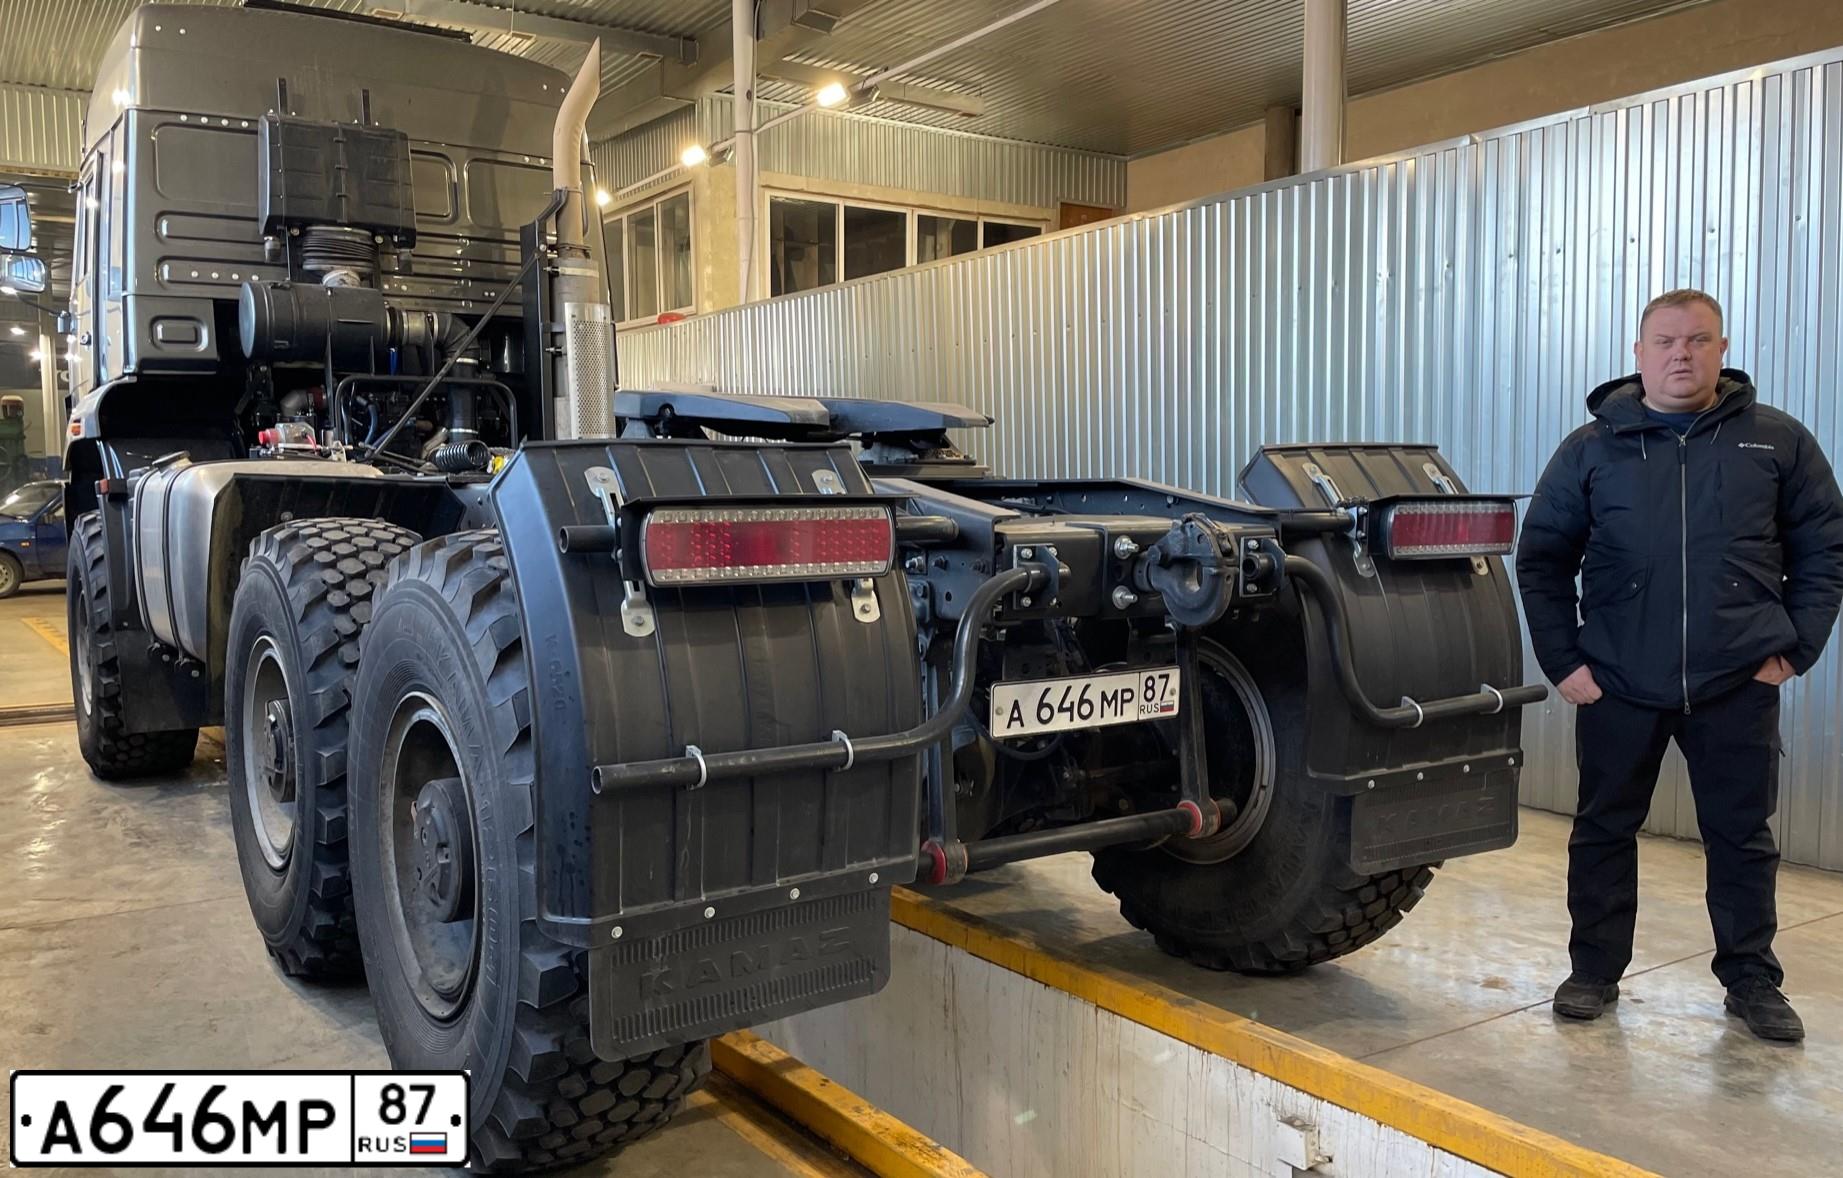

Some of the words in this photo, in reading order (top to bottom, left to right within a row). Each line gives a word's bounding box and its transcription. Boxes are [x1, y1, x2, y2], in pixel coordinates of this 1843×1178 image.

[1144, 673, 1170, 702] 87
[1140, 703, 1160, 715] RUS
[639, 926, 850, 999] KAMAZ
